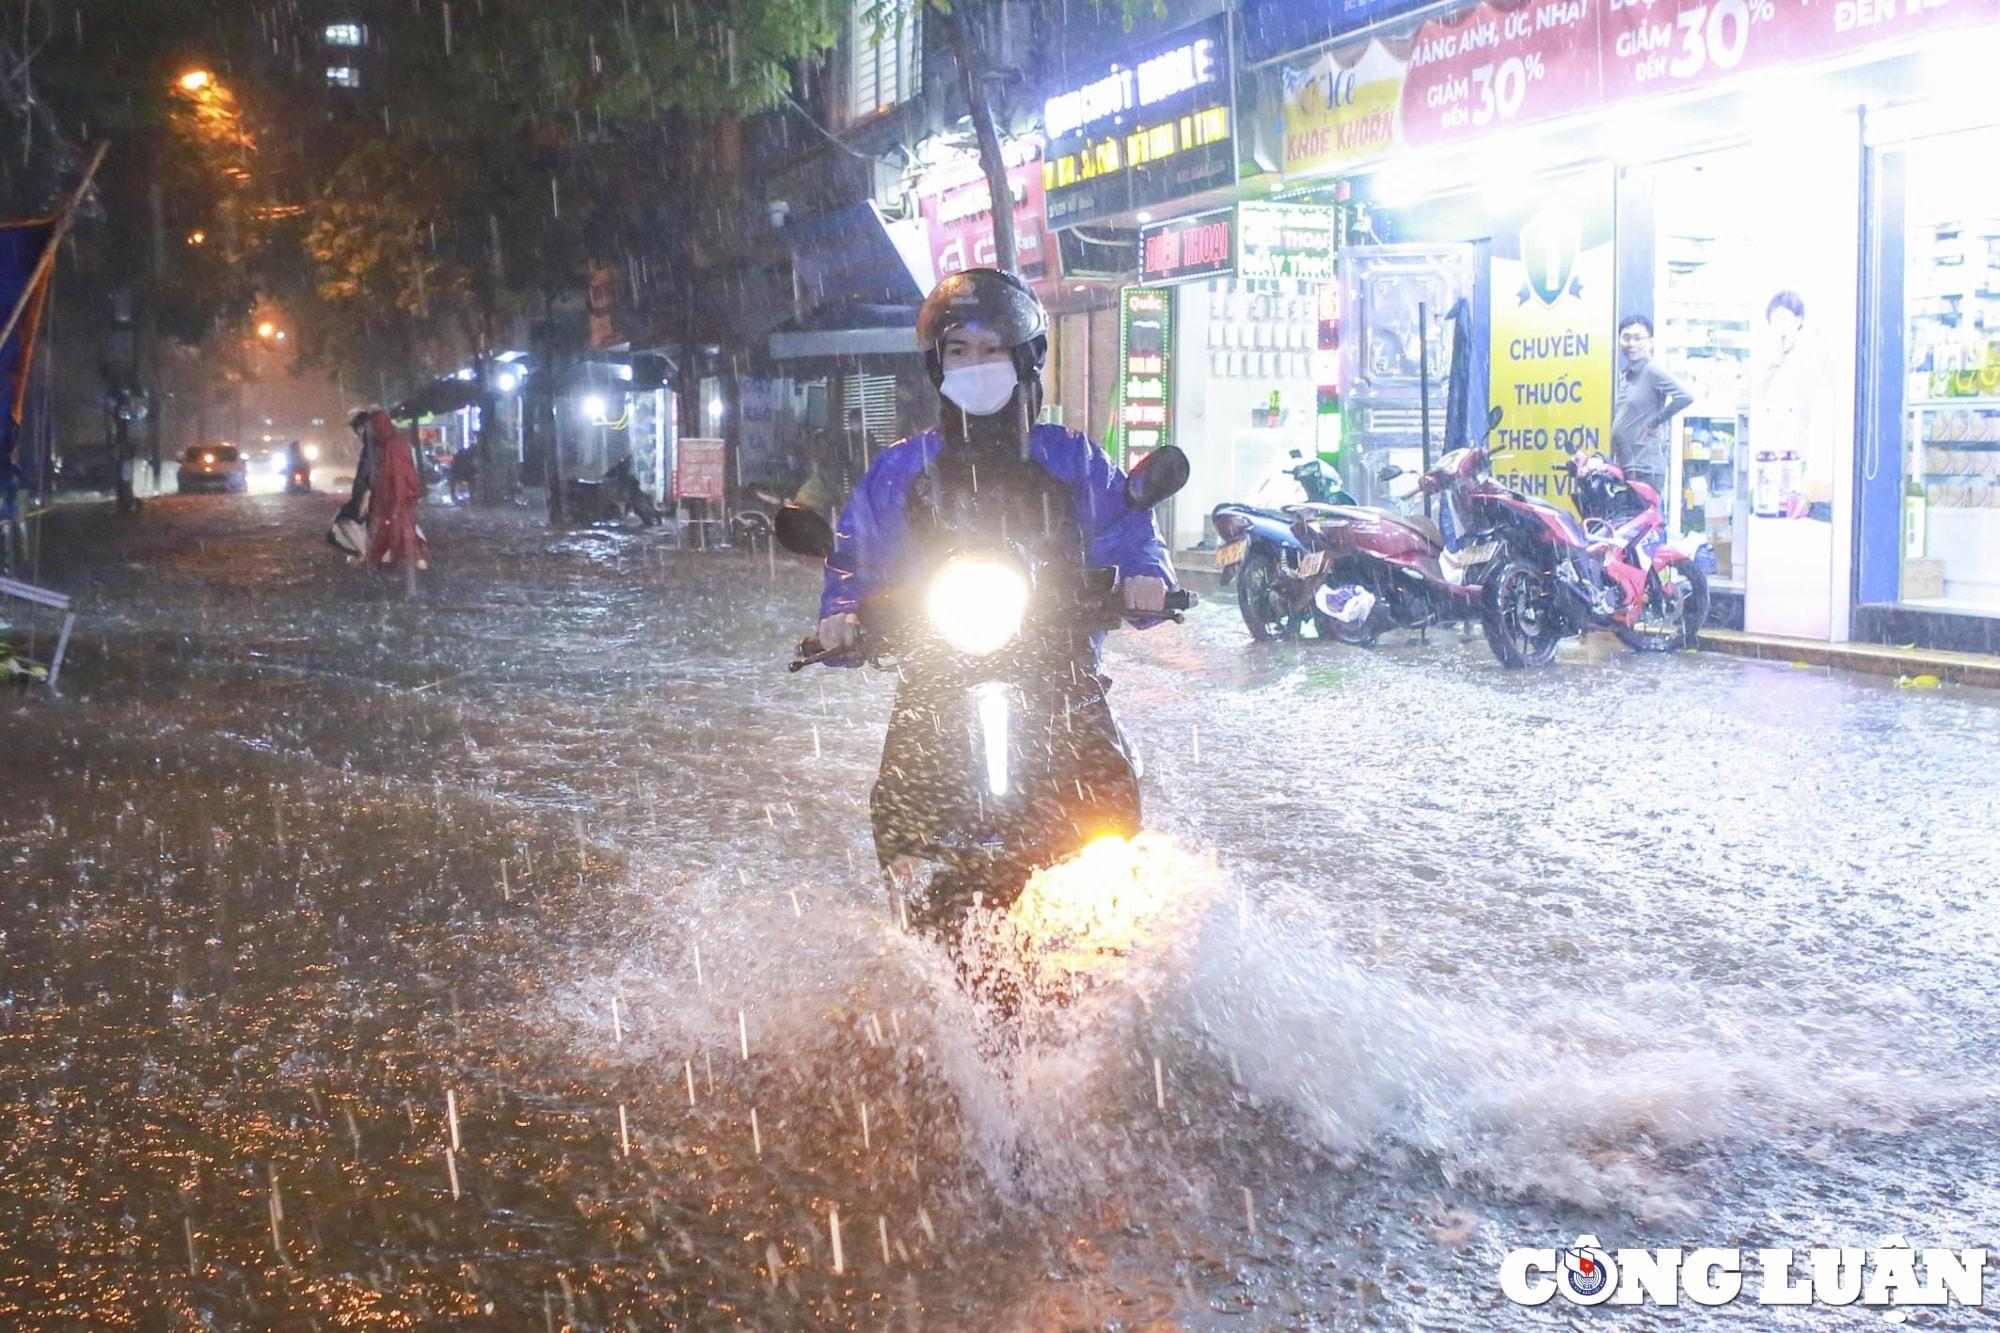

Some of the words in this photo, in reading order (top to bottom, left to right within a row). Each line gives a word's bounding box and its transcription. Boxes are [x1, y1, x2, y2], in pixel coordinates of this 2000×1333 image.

[1184, 222, 1228, 268] THOẠI
[1509, 329, 1590, 361] CHUYÊN
[1514, 373, 1583, 405] THUỐC
[1498, 428, 1548, 450] THEO
[1554, 425, 1600, 450] ĐƠN
